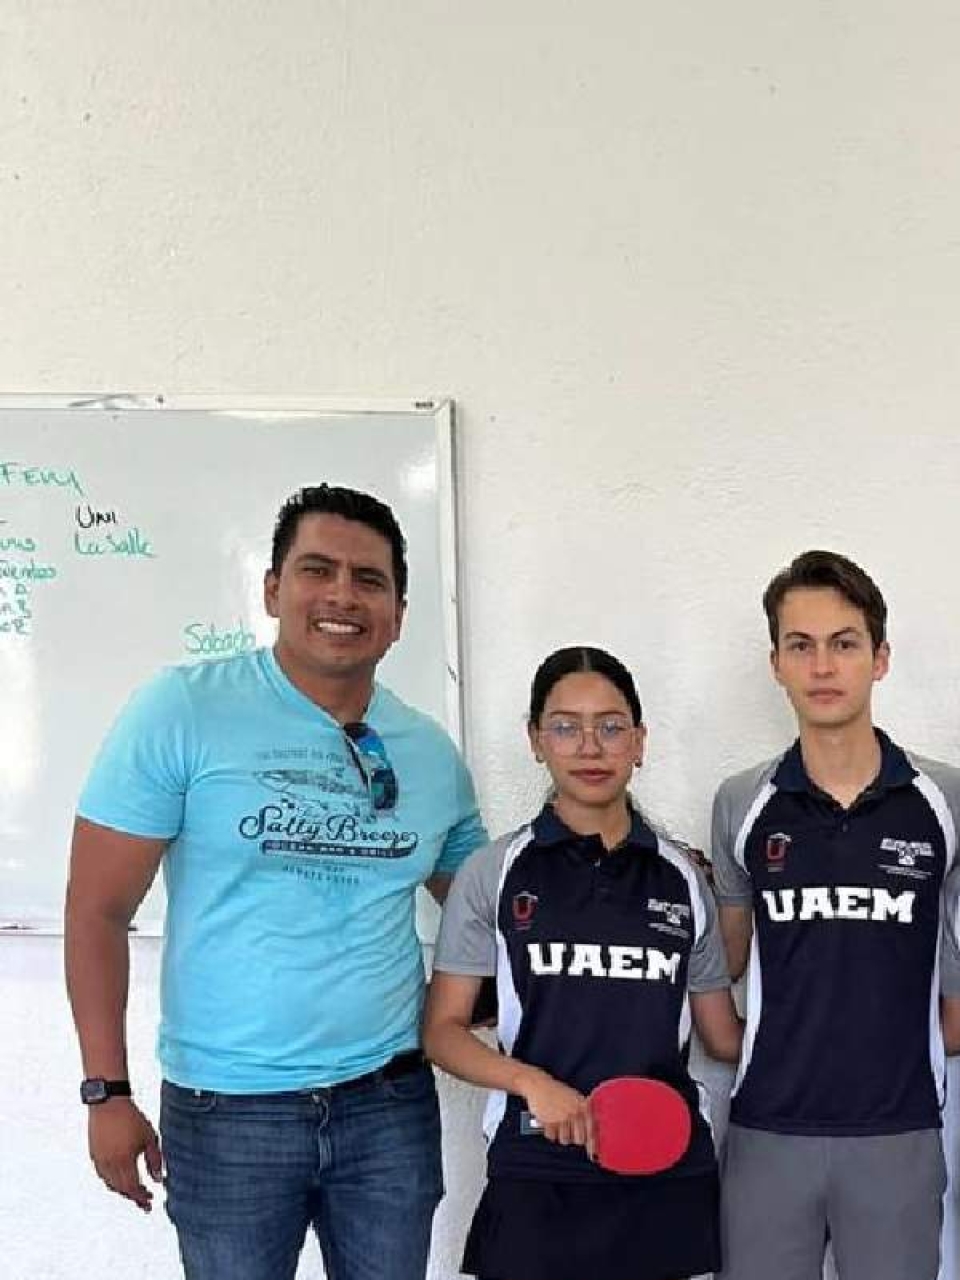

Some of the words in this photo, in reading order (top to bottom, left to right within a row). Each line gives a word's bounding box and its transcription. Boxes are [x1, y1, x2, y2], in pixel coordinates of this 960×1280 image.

[239, 806, 321, 841] Salty
[326, 814, 419, 848] Breeze
[762, 886, 916, 923] UAEM
[527, 942, 681, 984] UAEM
